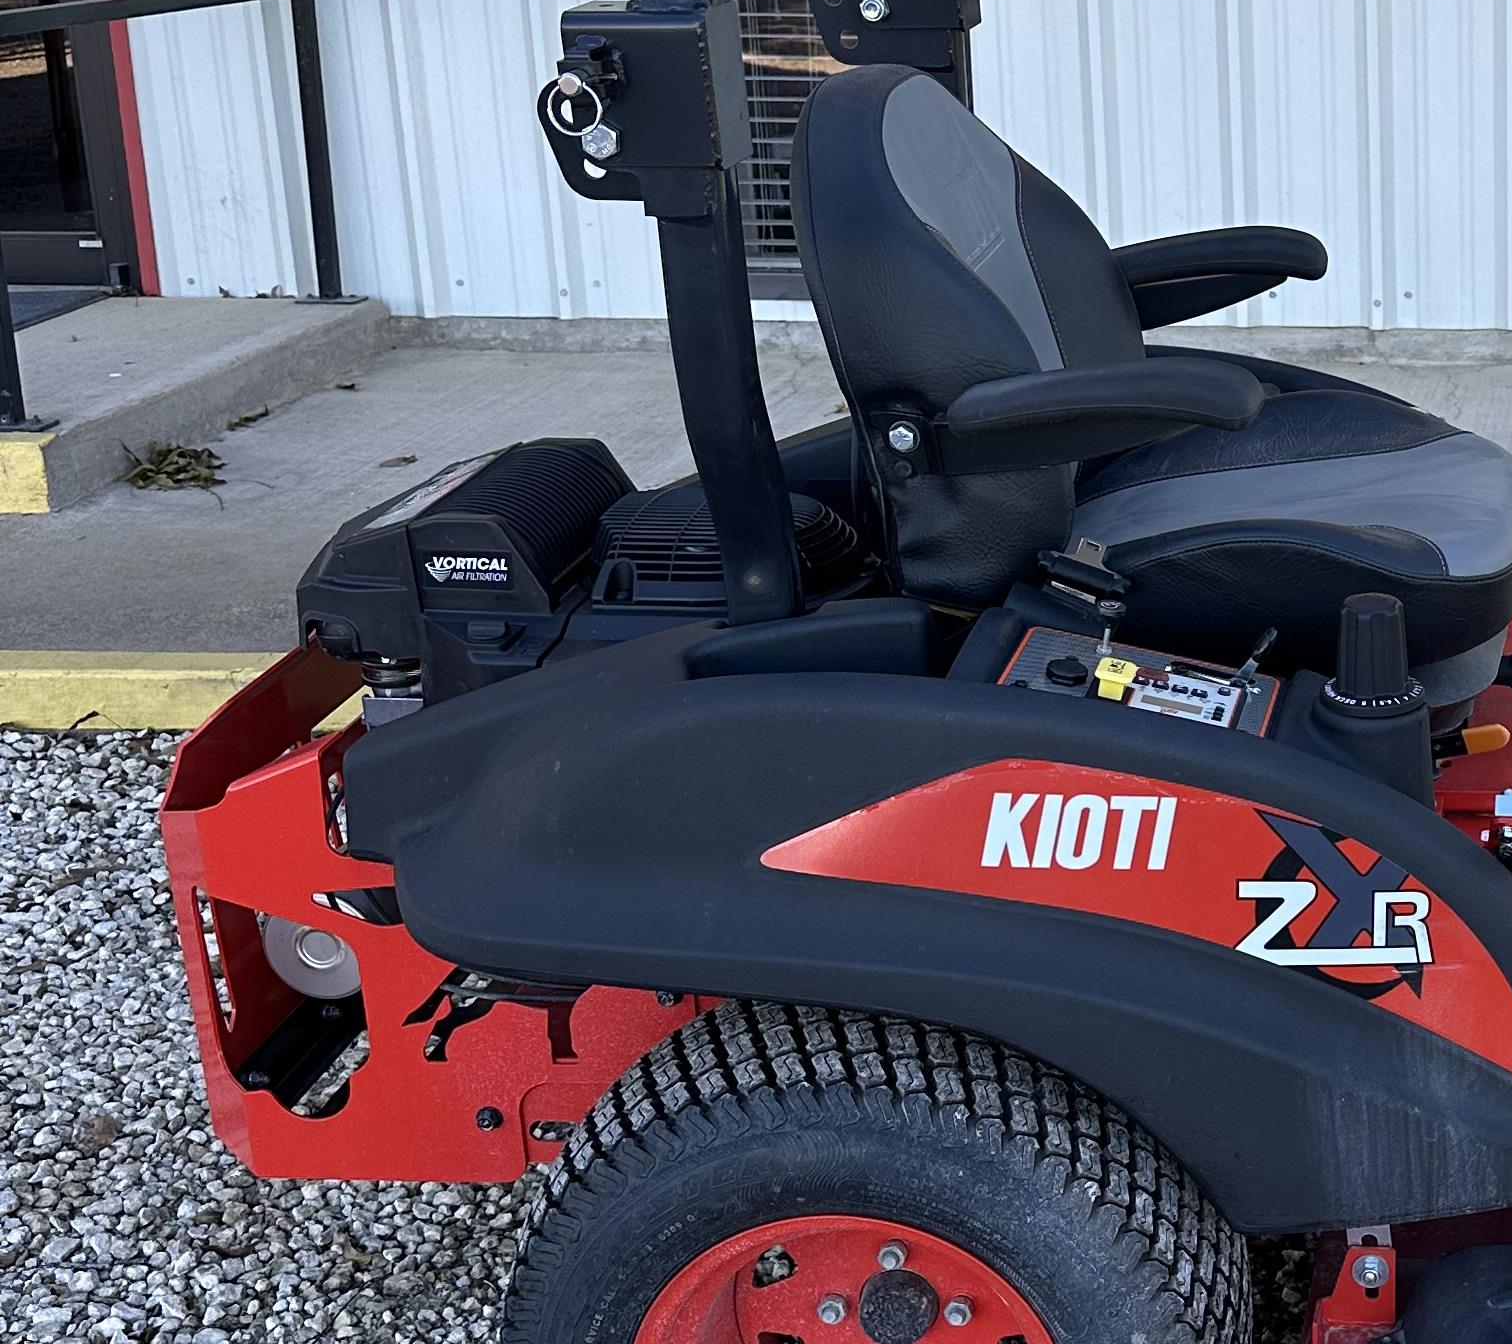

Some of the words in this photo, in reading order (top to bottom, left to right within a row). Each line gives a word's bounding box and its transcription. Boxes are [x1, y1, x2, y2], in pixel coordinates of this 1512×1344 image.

[432, 556, 509, 571] VORTICAL
[451, 571, 465, 581] AIR
[466, 571, 508, 582] FILTRATION
[980, 791, 1179, 871] KIOTI
